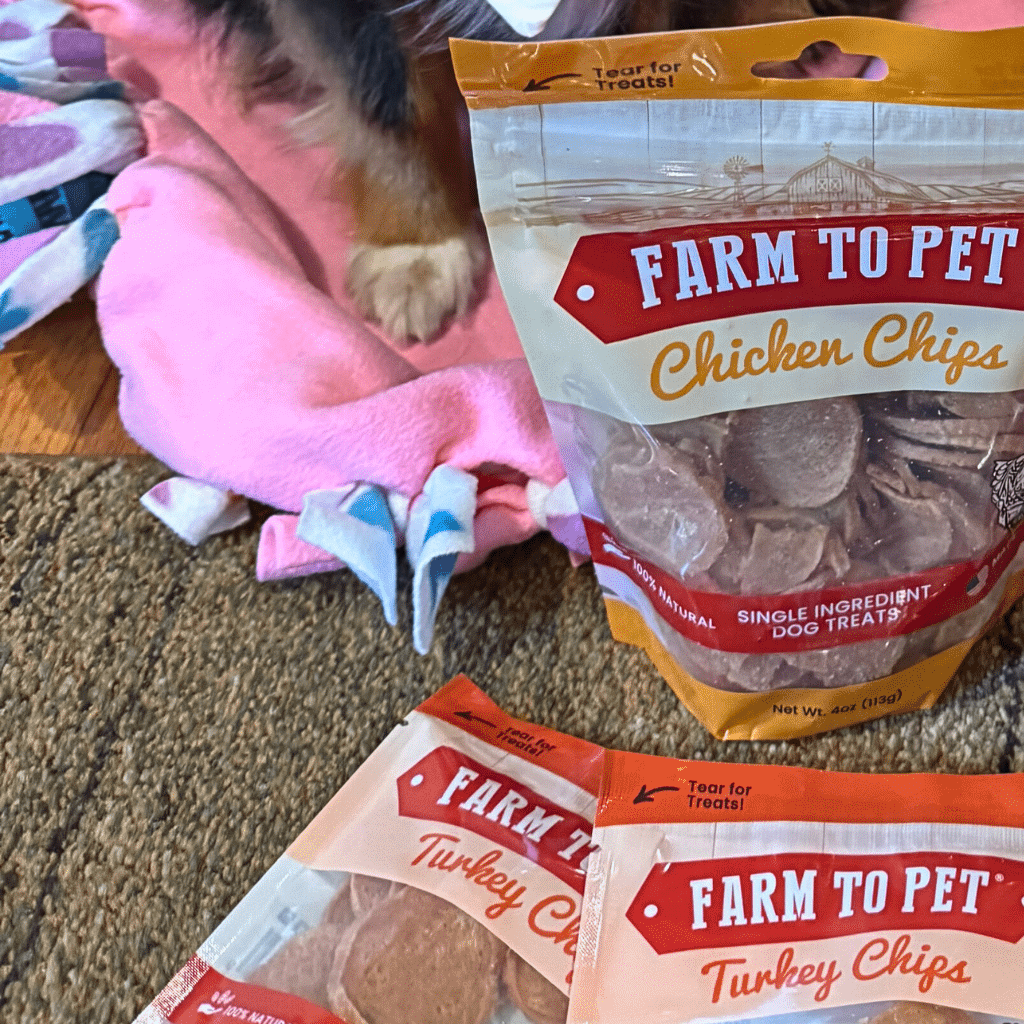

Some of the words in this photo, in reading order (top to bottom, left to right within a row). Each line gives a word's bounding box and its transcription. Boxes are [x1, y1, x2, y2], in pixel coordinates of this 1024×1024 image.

[592, 65, 645, 78] Tear
[650, 60, 681, 74] for
[595, 75, 674, 91] Treats!
[631, 228, 799, 310] FARM
[818, 226, 888, 280] TO
[649, 317, 853, 401] Chicken
[865, 311, 1008, 384] Chips
[632, 558, 657, 592] 100%
[658, 586, 717, 630] NATURAL
[737, 606, 808, 624] SINGLE
[814, 584, 932, 620] INGREDIENT
[772, 622, 820, 639] DOG
[825, 607, 900, 632] TREATS
[772, 704, 800, 716] Net
[802, 705, 827, 718] Wt.
[830, 703, 857, 716] 4oz
[861, 688, 904, 711] (113g)
[437, 766, 565, 843] FARM
[686, 794, 745, 811] Treats!
[688, 780, 726, 796] Tear
[729, 781, 753, 796] for
[411, 833, 528, 919] Turkey
[690, 870, 817, 931] FARM
[834, 870, 890, 919] TO
[701, 947, 843, 1003] Turkey
[852, 933, 972, 995] Chips
[222, 1005, 250, 1020] 100%
